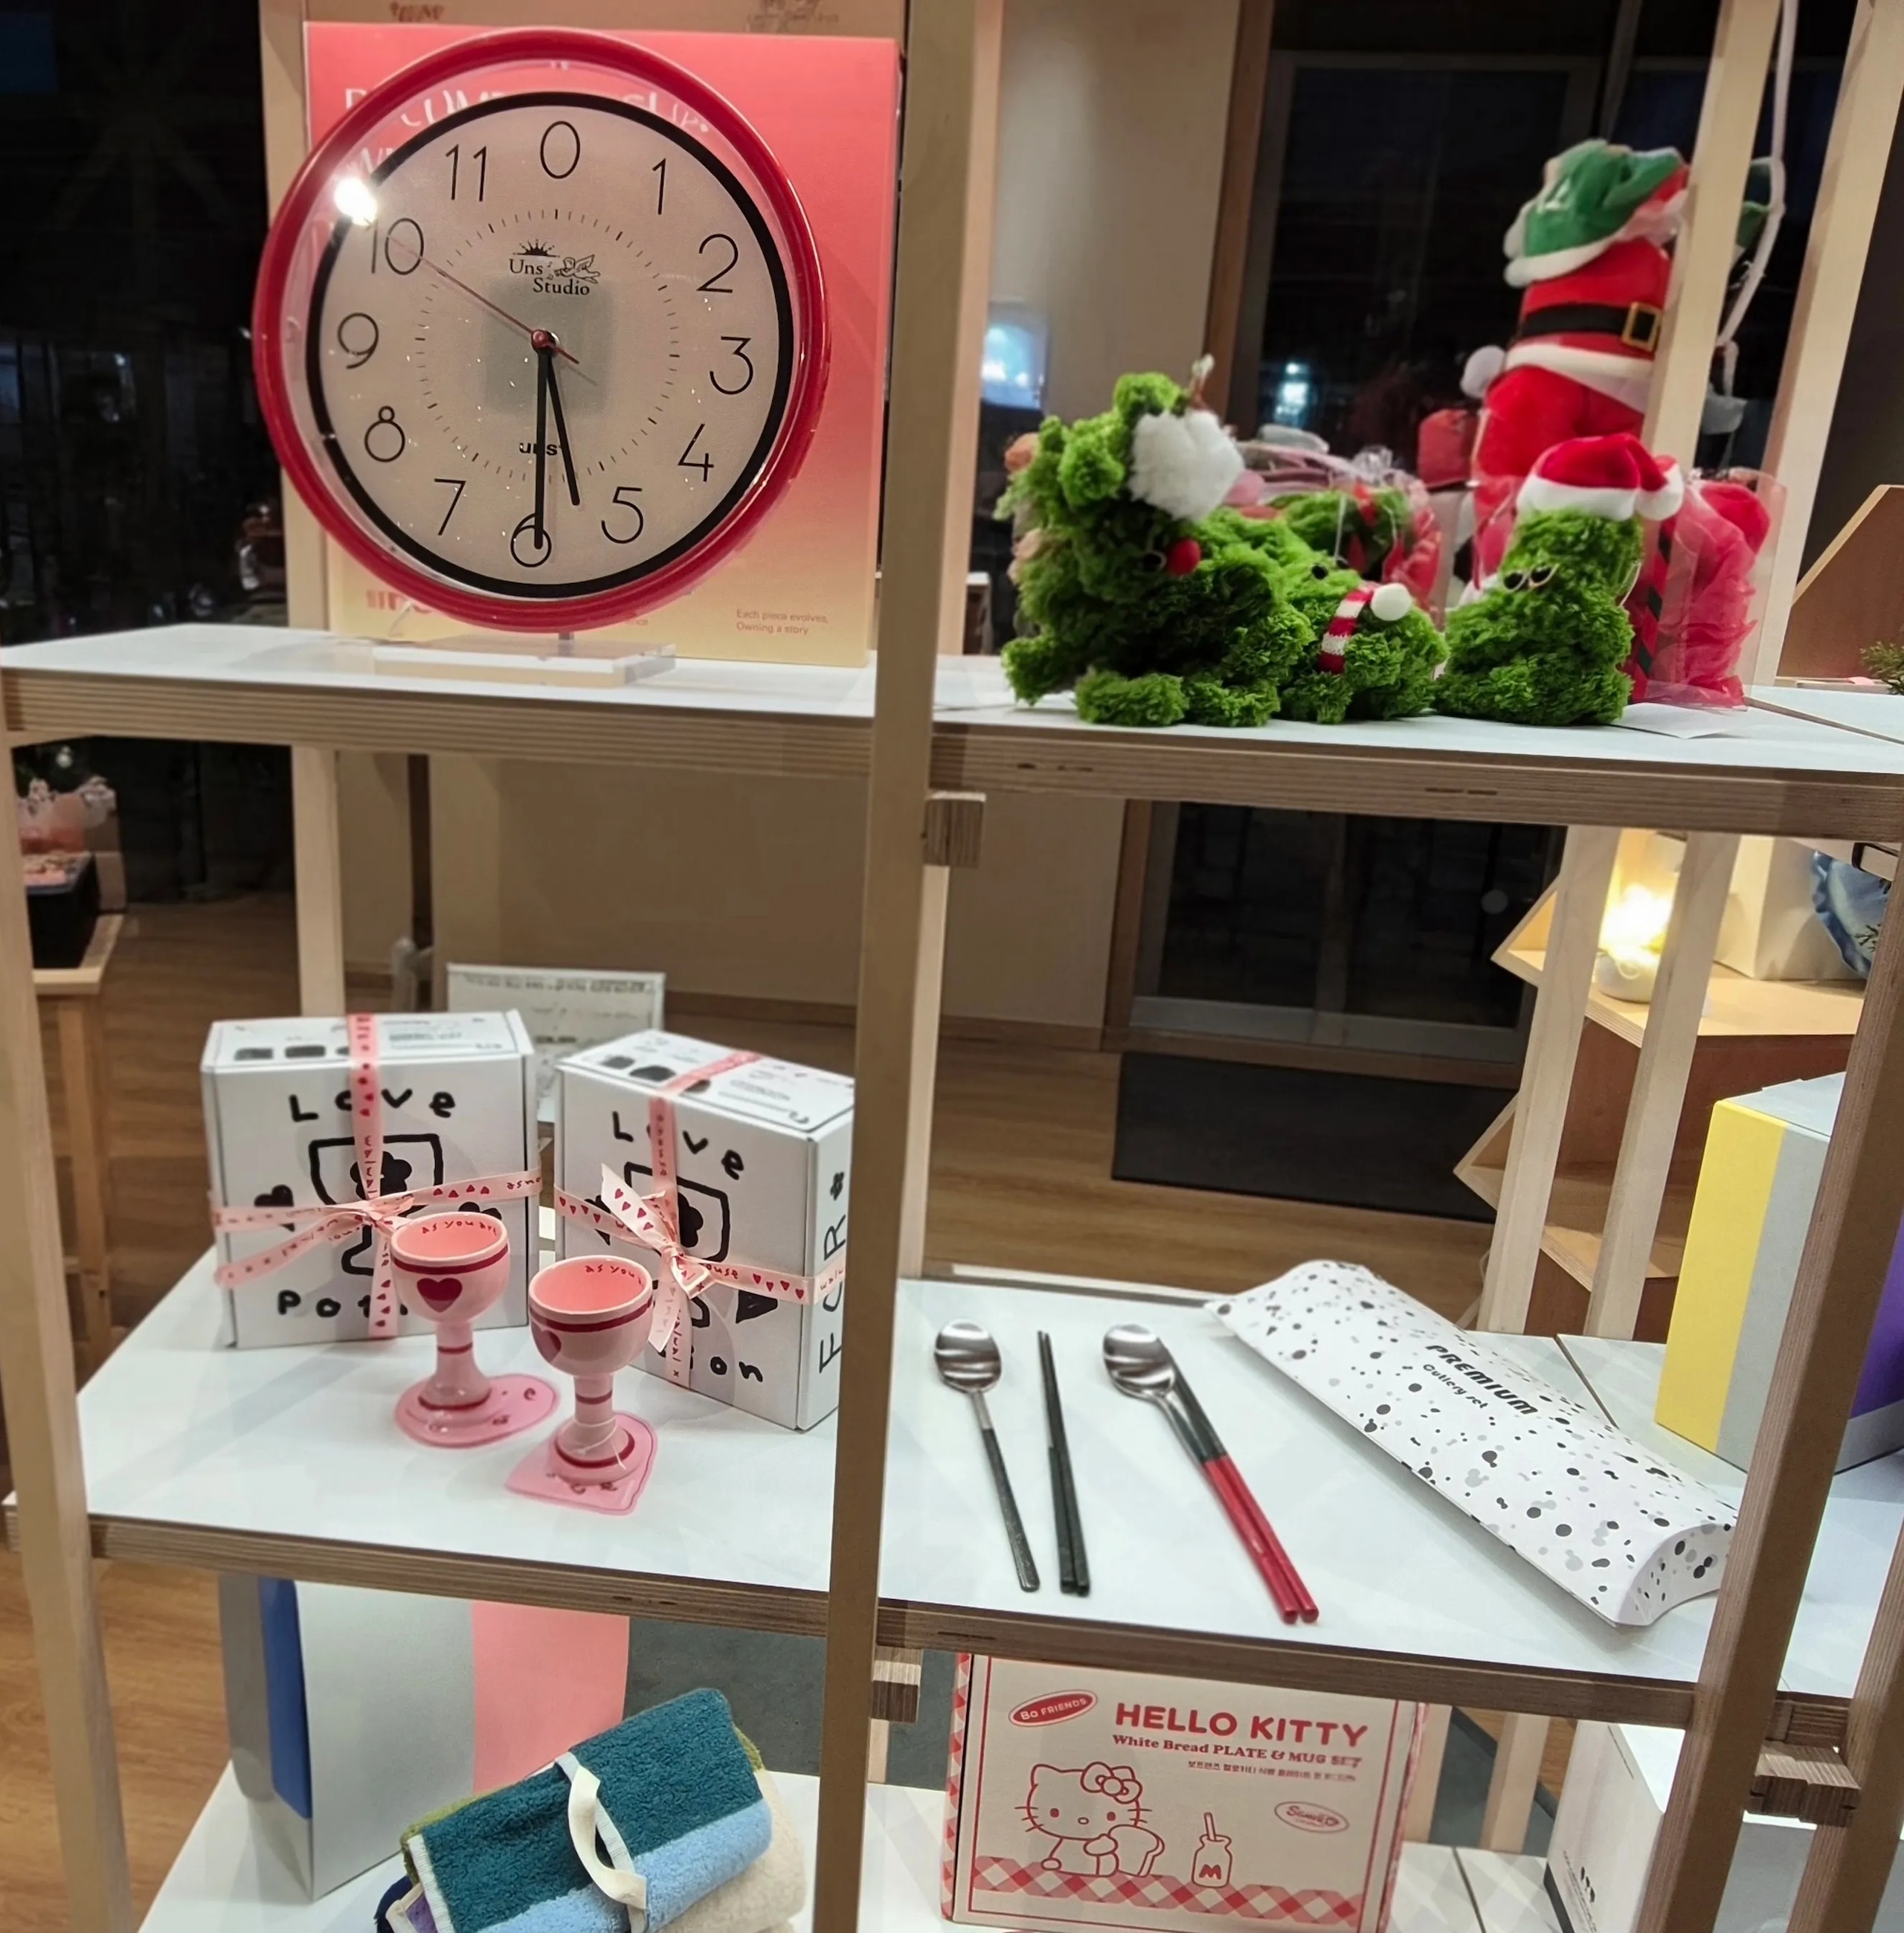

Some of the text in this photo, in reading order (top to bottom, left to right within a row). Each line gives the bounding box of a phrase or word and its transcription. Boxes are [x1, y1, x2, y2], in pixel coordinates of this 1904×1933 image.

[446, 144, 487, 202] 11
[541, 120, 580, 178] 0
[651, 158, 667, 215] 1
[369, 218, 424, 276] 10
[509, 258, 543, 274] Uns
[697, 234, 739, 294] 2
[533, 277, 591, 295] Studio
[338, 313, 379, 370] 9
[710, 337, 753, 395] 3
[364, 405, 405, 463] 8
[678, 424, 715, 481] 4
[434, 478, 466, 535] 7
[601, 487, 643, 544] 5
[510, 513, 552, 567] 6
[736, 621, 774, 634] Owning
[784, 625, 808, 636] story
[612, 1111, 744, 1180] Lve
[445, 1220, 474, 1229] you
[610, 1265, 635, 1278] you
[1423, 1364, 1488, 1409] Cutlery set
[1425, 1345, 1538, 1415] PREMIUM
[1020, 1697, 1087, 1720] Bo FRIENDS
[1115, 1702, 1368, 1747] HELLO KITTY
[1112, 1734, 1160, 1749] White
[1162, 1739, 1209, 1754] Bread
[1212, 1744, 1268, 1760] PLATE
[1270, 1749, 1285, 1760] &
[1288, 1751, 1325, 1765] MUG
[1198, 1863, 1222, 1880] M
